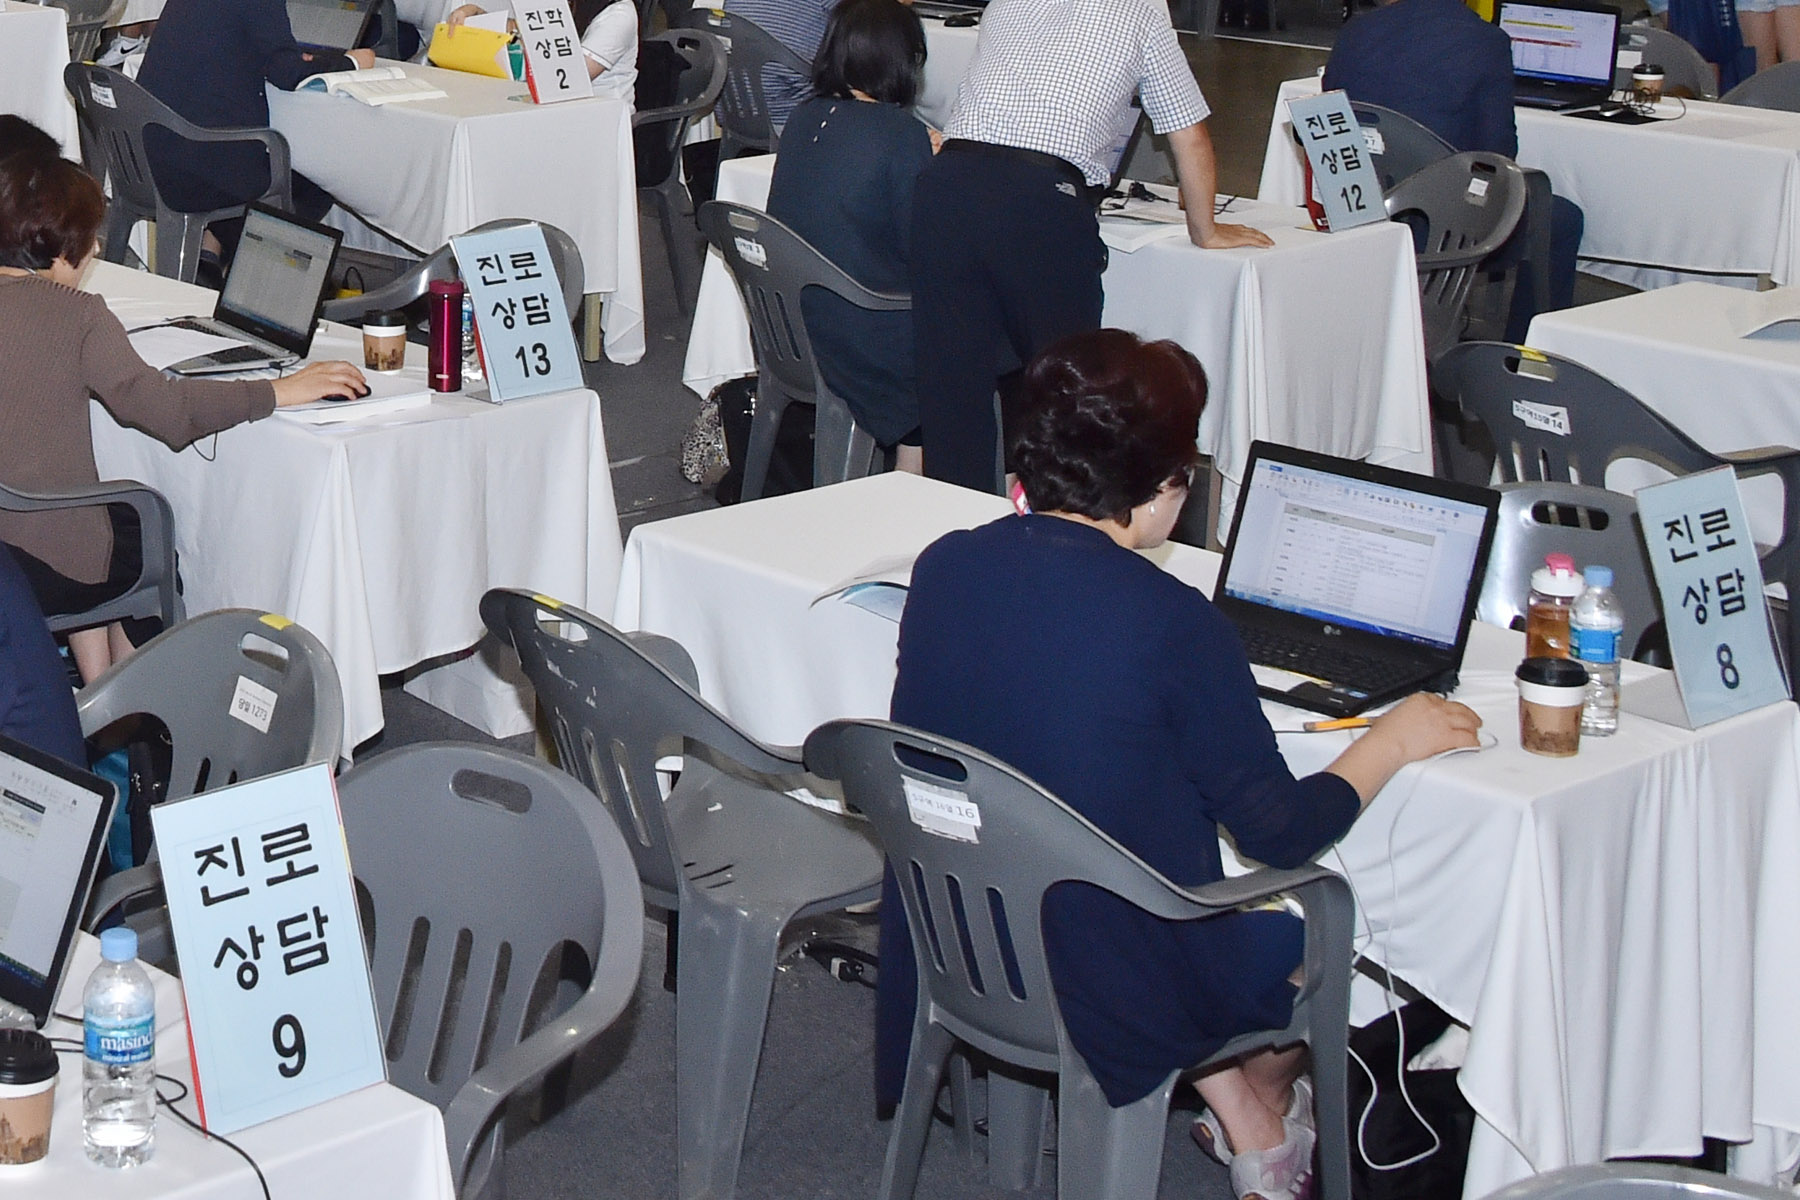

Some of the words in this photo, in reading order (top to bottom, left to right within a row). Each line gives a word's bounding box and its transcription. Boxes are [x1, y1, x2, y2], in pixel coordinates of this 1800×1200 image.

[524, 6, 565, 32] 진학
[534, 33, 574, 58] 상담
[556, 67, 571, 91] 2
[1304, 110, 1352, 142] 진로
[1320, 145, 1362, 175] 상담
[1340, 185, 1367, 214] 12
[475, 250, 543, 287] 진로
[492, 292, 552, 331] 상담
[514, 342, 552, 379] 13
[1663, 506, 1738, 564] 진로
[1681, 567, 1746, 627] 상담
[1715, 642, 1741, 691] 8
[193, 822, 321, 907] 진로
[211, 906, 330, 991] 상담
[271, 1013, 308, 1079] 9
